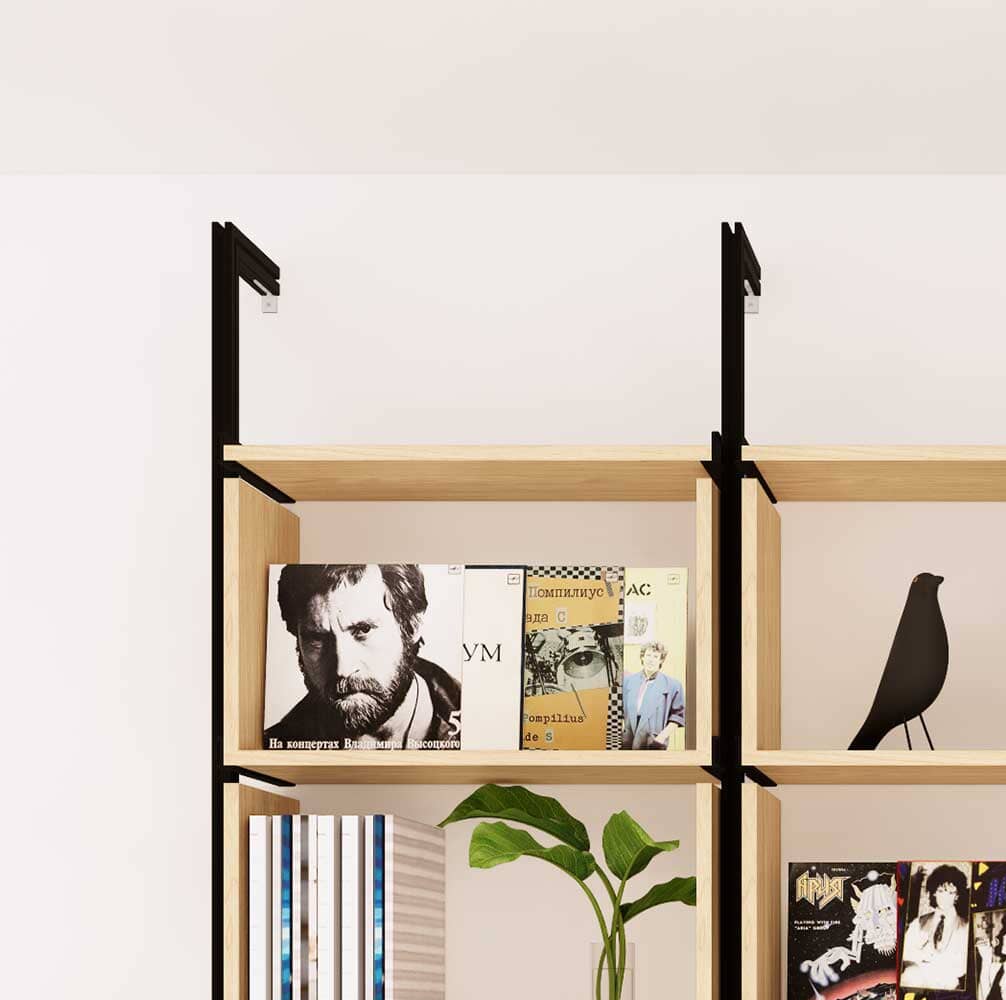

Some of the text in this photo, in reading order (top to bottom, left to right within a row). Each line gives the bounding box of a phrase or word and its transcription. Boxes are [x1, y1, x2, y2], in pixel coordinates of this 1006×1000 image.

[528, 584, 604, 600] Помпилиус
[626, 583, 652, 597] АС
[462, 643, 502, 662] УМ
[269, 738, 460, 750] На концертах Владимира Высоцкого
